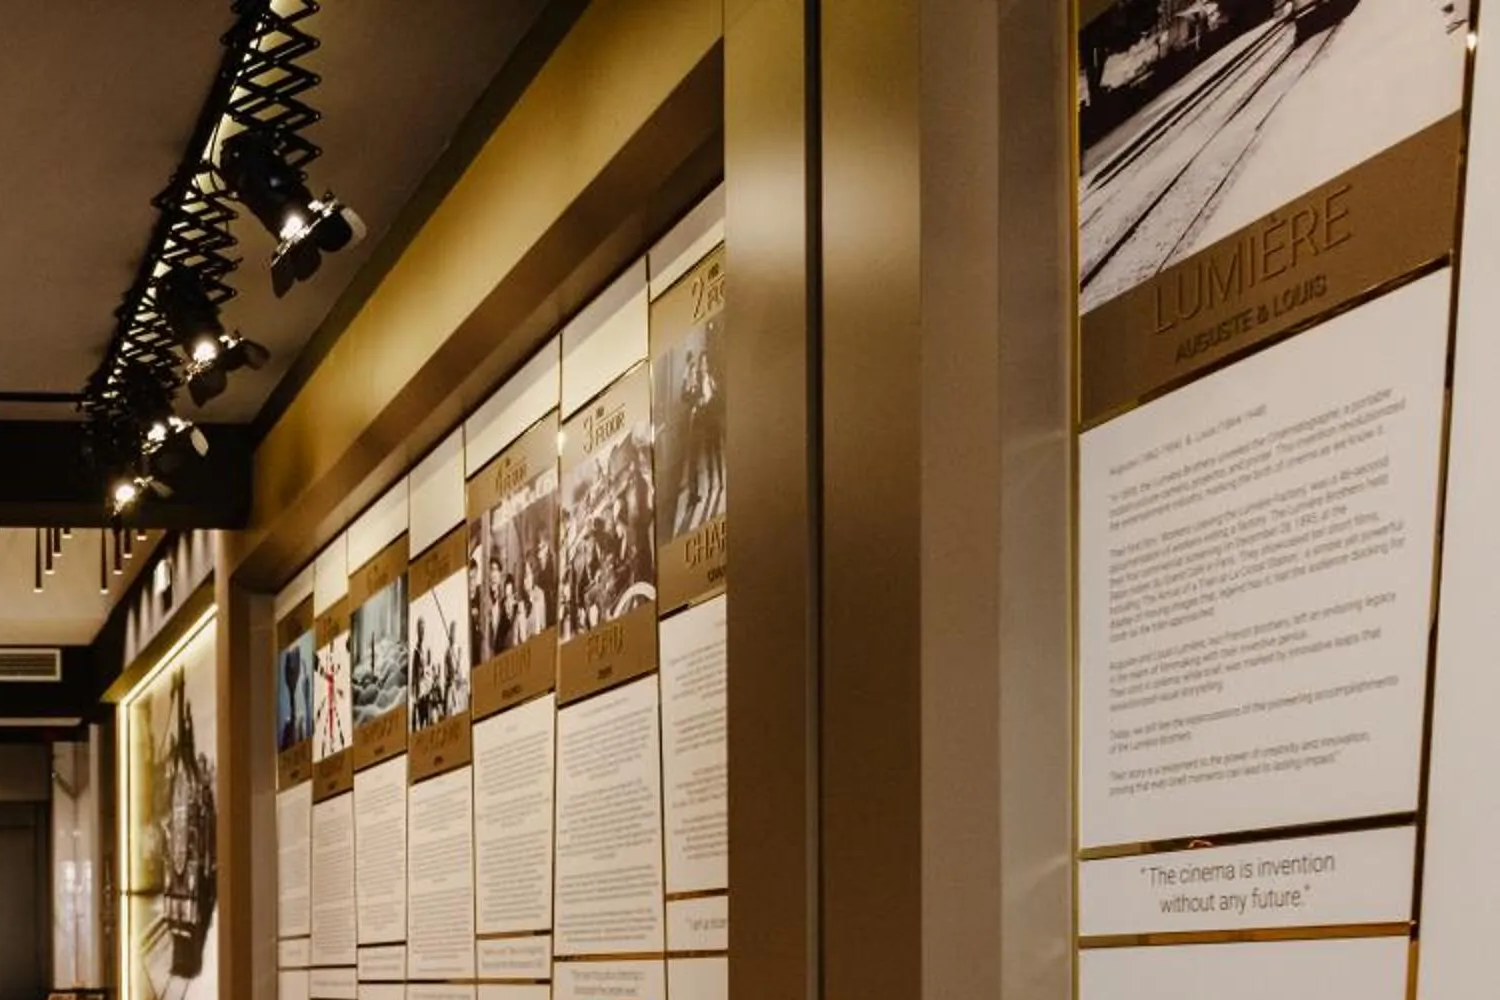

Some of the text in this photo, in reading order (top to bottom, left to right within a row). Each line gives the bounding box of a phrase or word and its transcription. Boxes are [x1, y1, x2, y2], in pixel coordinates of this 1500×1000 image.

[1154, 184, 1353, 336] LUMIÈRE
[1175, 273, 1328, 365] AUGUSTE & LOUIS
[1179, 863, 1235, 884] cinema
[1239, 861, 1253, 879] is
[1257, 854, 1336, 878] invention
[1159, 892, 1216, 914] without
[1219, 894, 1248, 916] any
